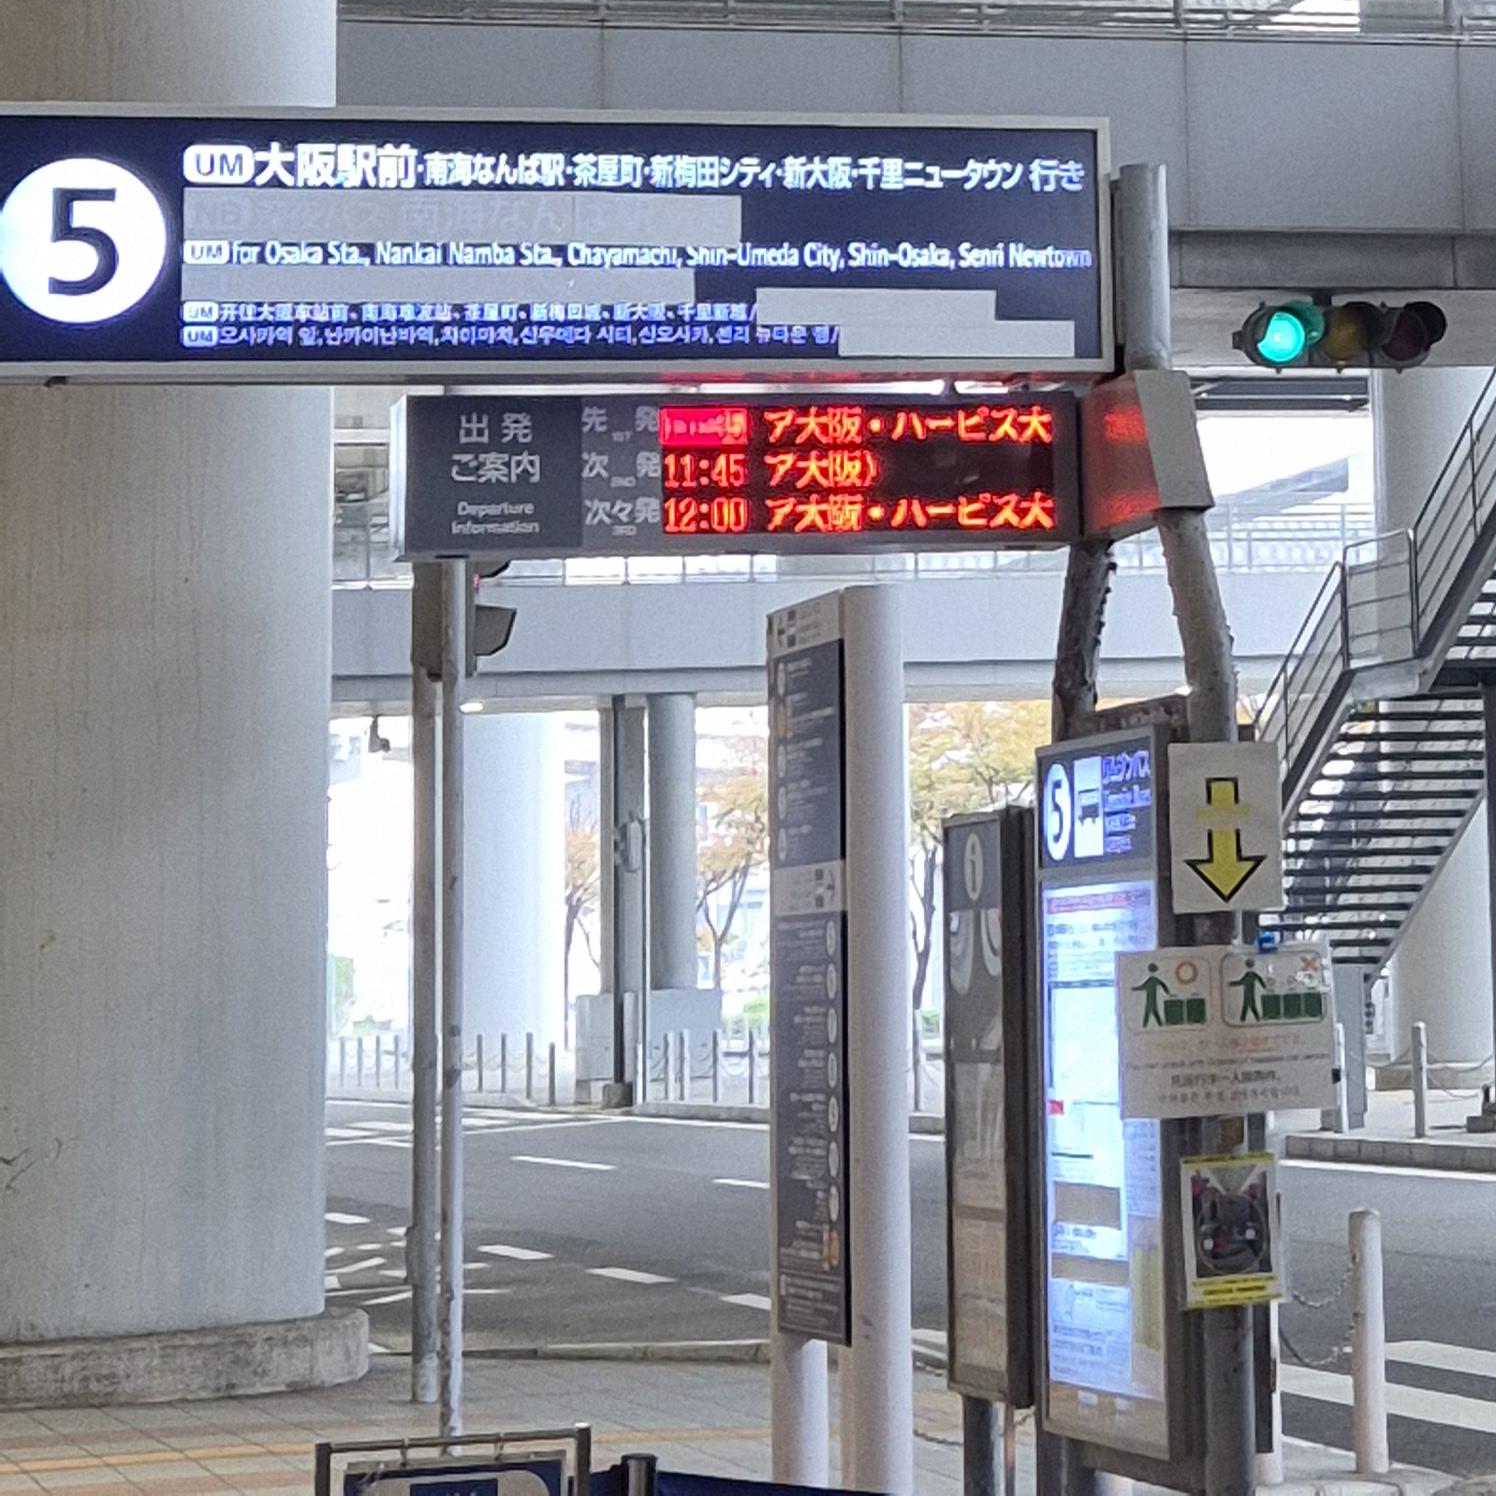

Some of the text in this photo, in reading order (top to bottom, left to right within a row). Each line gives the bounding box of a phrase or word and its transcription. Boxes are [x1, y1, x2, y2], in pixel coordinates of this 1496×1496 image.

[190, 150, 248, 180] UM
[47, 186, 120, 296] 5
[231, 242, 258, 263] for
[264, 242, 323, 264] Osaka
[375, 242, 442, 264] Nankai
[449, 242, 515, 264] Namba
[567, 243, 683, 272] Chayamachi,
[686, 243, 800, 269] Shin-Umeda
[803, 243, 845, 272] City,
[848, 243, 955, 272] Shin-Osaka,
[958, 244, 1005, 269] Senri
[1008, 243, 1094, 270] Newtown
[449, 450, 541, 485] ご案内
[663, 453, 748, 488] 11:45
[456, 500, 535, 518] Departure
[583, 496, 661, 526] 次々発
[663, 496, 749, 533] 12:00
[450, 519, 541, 536] Information
[1050, 779, 1064, 844] 5
